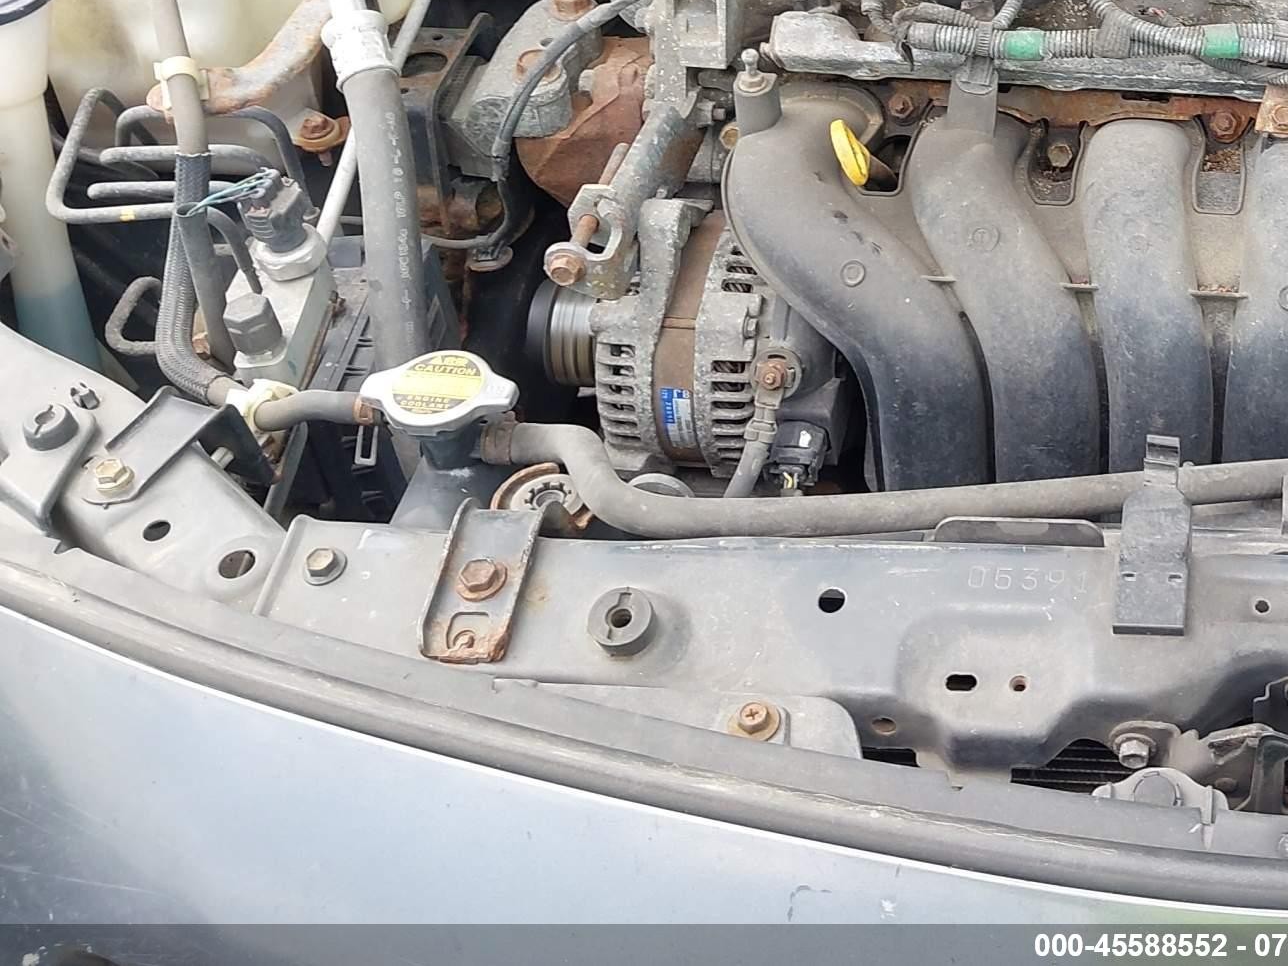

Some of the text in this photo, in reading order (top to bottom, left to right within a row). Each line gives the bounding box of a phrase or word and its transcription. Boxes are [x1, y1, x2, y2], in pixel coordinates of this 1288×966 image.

[414, 363, 477, 376] CAUTION
[406, 394, 450, 404] ENGINE
[400, 400, 451, 410] COOLANT
